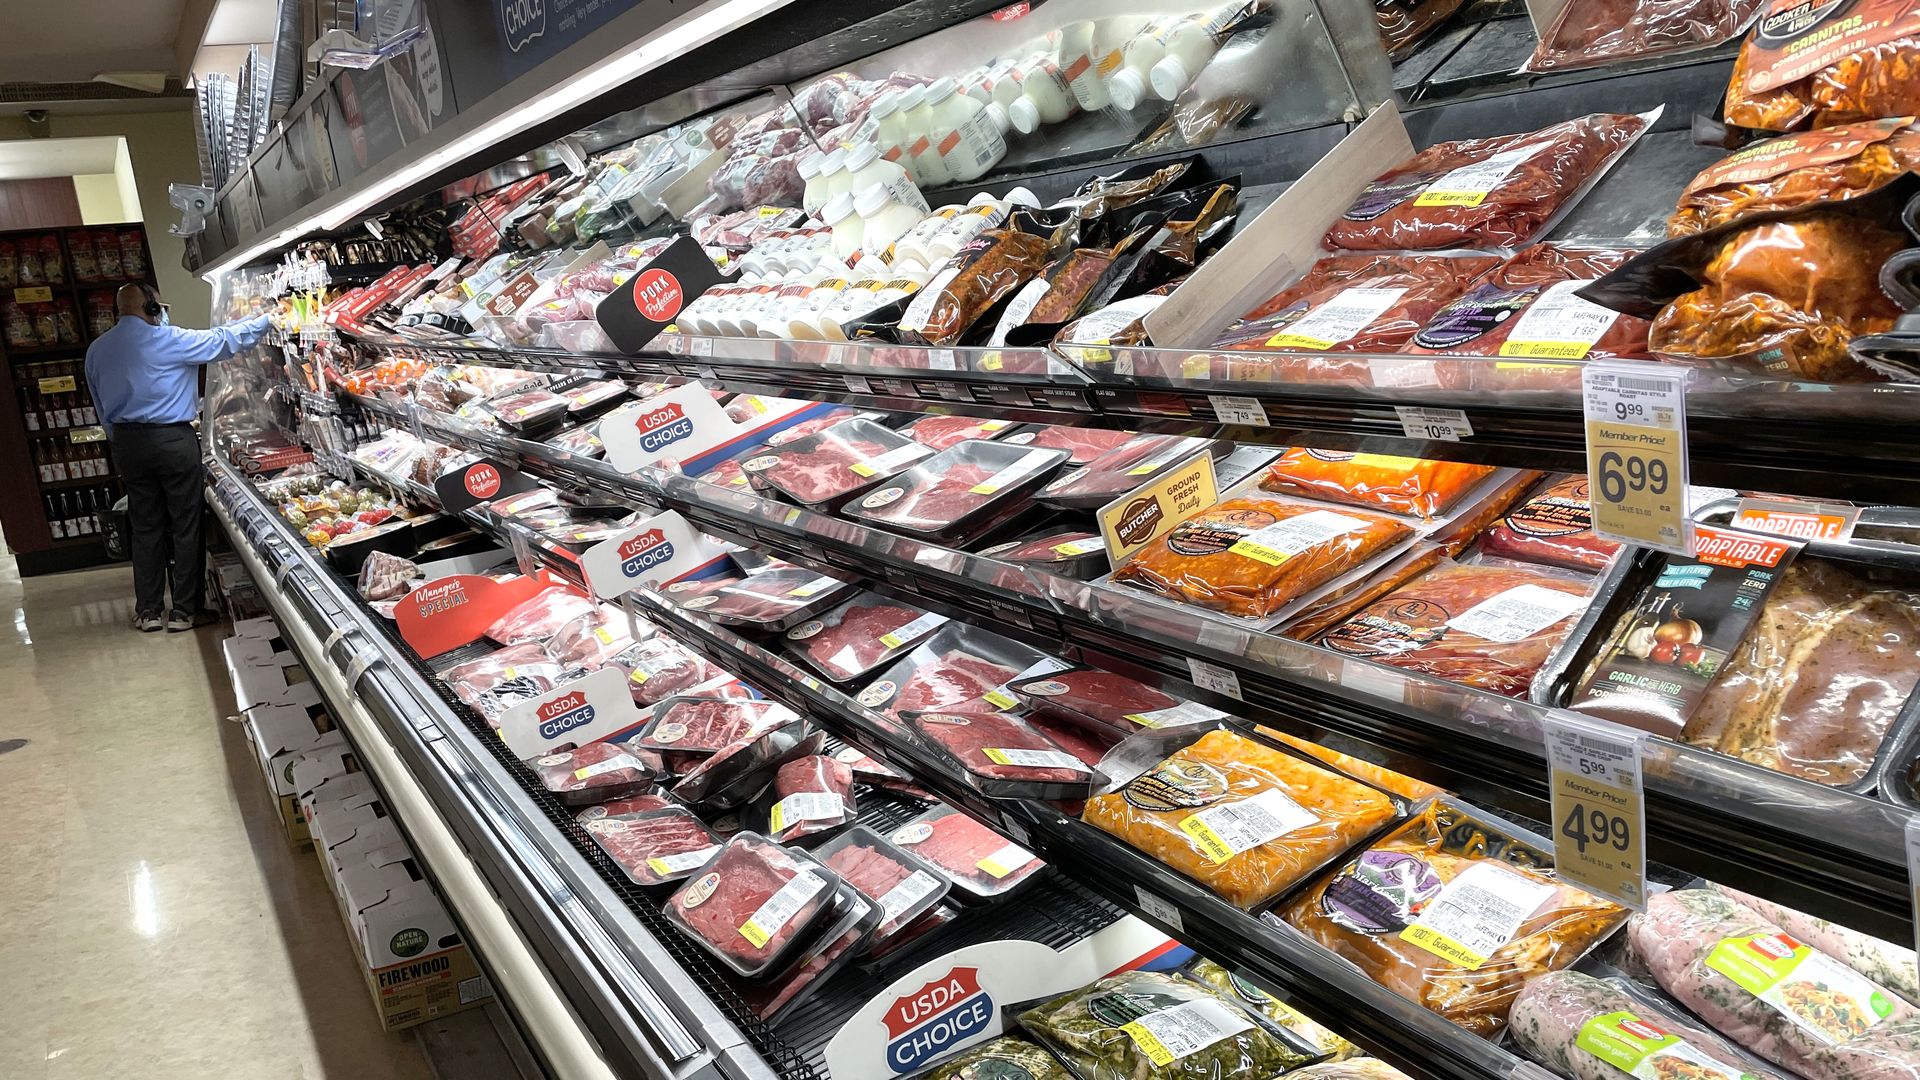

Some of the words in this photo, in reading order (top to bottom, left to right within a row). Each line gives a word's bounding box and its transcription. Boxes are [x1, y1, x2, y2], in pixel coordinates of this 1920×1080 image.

[506, 0, 543, 34] CHOICE
[1764, 3, 1810, 31] COOKER
[1772, 46, 1817, 70] BONELESS
[1818, 34, 1844, 52] PORK
[1845, 20, 1879, 37] ROAST
[1790, 14, 1863, 53] CARNITAS
[1821, 53, 1831, 65] OZ
[1733, 140, 1798, 161] CARNITAS
[640, 275, 670, 303] PORK
[1508, 343, 1527, 354] 100%
[1529, 344, 1580, 356] Guaranteed
[1758, 348, 1783, 362] PORK
[644, 408, 677, 428] USDA
[644, 421, 691, 448] CHOICE
[1599, 429, 1638, 442] Member
[1639, 434, 1666, 445] Price!
[470, 468, 493, 484] PORK
[1167, 471, 1201, 496] GROUND
[1173, 483, 1199, 503] FRESH
[1177, 495, 1200, 514] Daily
[1617, 504, 1635, 514] SAVE
[1659, 504, 1671, 512] ea
[1119, 503, 1159, 539] BUTCHER
[1743, 513, 1839, 541] ADAPTABLE
[626, 534, 658, 554] USDA
[626, 545, 672, 573] CHOICE
[1702, 555, 1743, 567] MEALS
[1742, 578, 1767, 590] ZERO
[1748, 569, 1773, 580] PORK
[416, 579, 461, 604] Manager's
[419, 591, 469, 617] SPECIAL
[1609, 670, 1649, 686] GARLIC
[1658, 681, 1682, 695] HERB
[545, 696, 579, 716] USDA
[544, 709, 592, 735] CHOICE
[1565, 779, 1601, 797] Member
[1602, 790, 1628, 806] Price!
[1199, 830, 1228, 858] Guaranteed
[1580, 854, 1596, 865] SAVE
[396, 937, 423, 949] NATURE
[399, 930, 419, 941] OPEN
[1474, 923, 1499, 940] SAFEWAY
[1412, 927, 1432, 943] 100%
[1432, 938, 1481, 964] Guaranteed
[378, 956, 450, 987] FIREWOOD
[900, 979, 965, 1023] USDA
[896, 1001, 987, 1064] CHOICE
[1588, 1034, 1613, 1051] lemon
[1611, 1047, 1634, 1063] garlic
